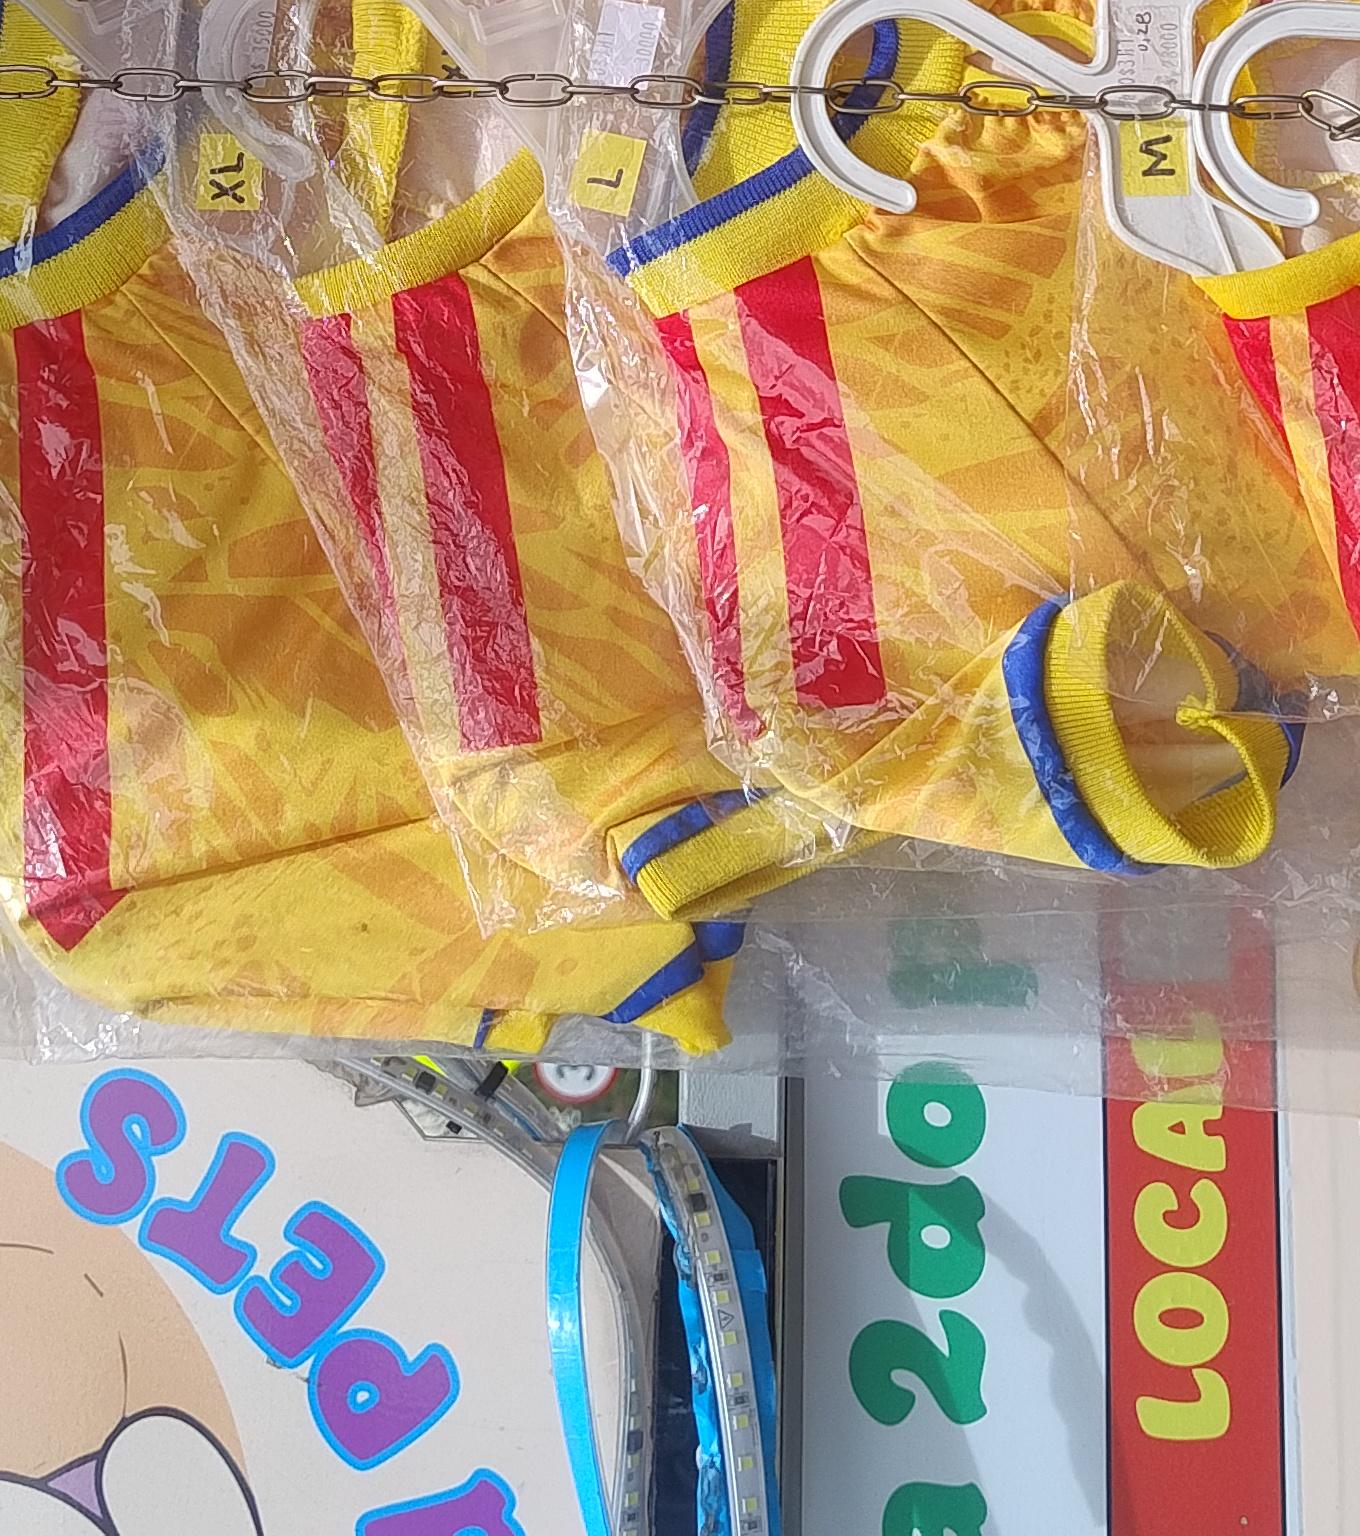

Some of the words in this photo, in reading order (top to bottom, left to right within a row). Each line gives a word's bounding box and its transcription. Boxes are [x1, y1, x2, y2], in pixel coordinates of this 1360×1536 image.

[251, 9, 276, 52] 35000
[208, 151, 246, 205] XL
[586, 168, 624, 190] L
[1139, 134, 1176, 178] M
[837, 1061, 988, 1427] 2do
[1131, 1010, 1232, 1440] LOCAL
[53, 1066, 460, 1469] PETS
